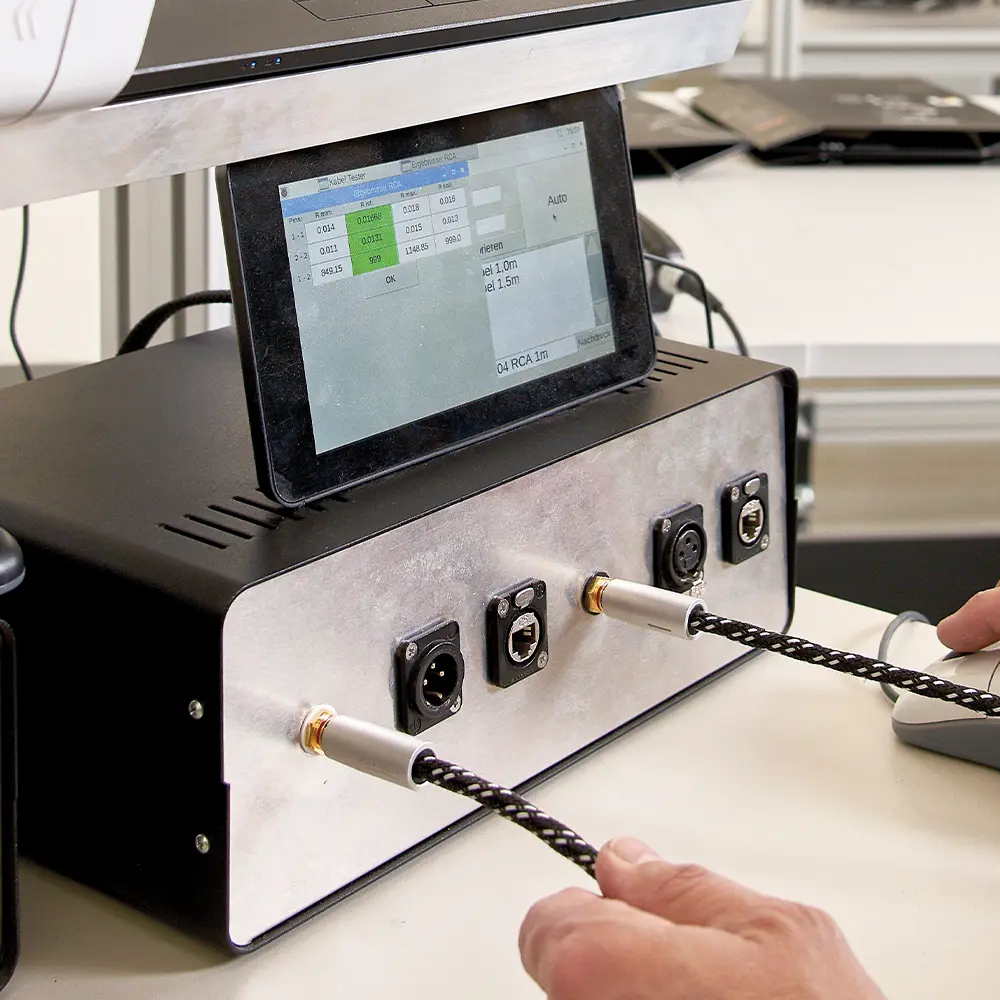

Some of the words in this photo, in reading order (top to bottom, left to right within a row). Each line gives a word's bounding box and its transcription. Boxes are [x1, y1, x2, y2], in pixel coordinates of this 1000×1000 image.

[439, 194, 456, 206] 0.016
[547, 193, 568, 206] Auto
[442, 214, 459, 226] 0.013
[316, 223, 335, 235] 0.014
[405, 222, 423, 234] 0.015
[319, 244, 338, 256] 0.011
[385, 273, 397, 285] OK
[497, 361, 509, 375] 04
[511, 353, 533, 370] RCA
[535, 348, 549, 362] 1m
